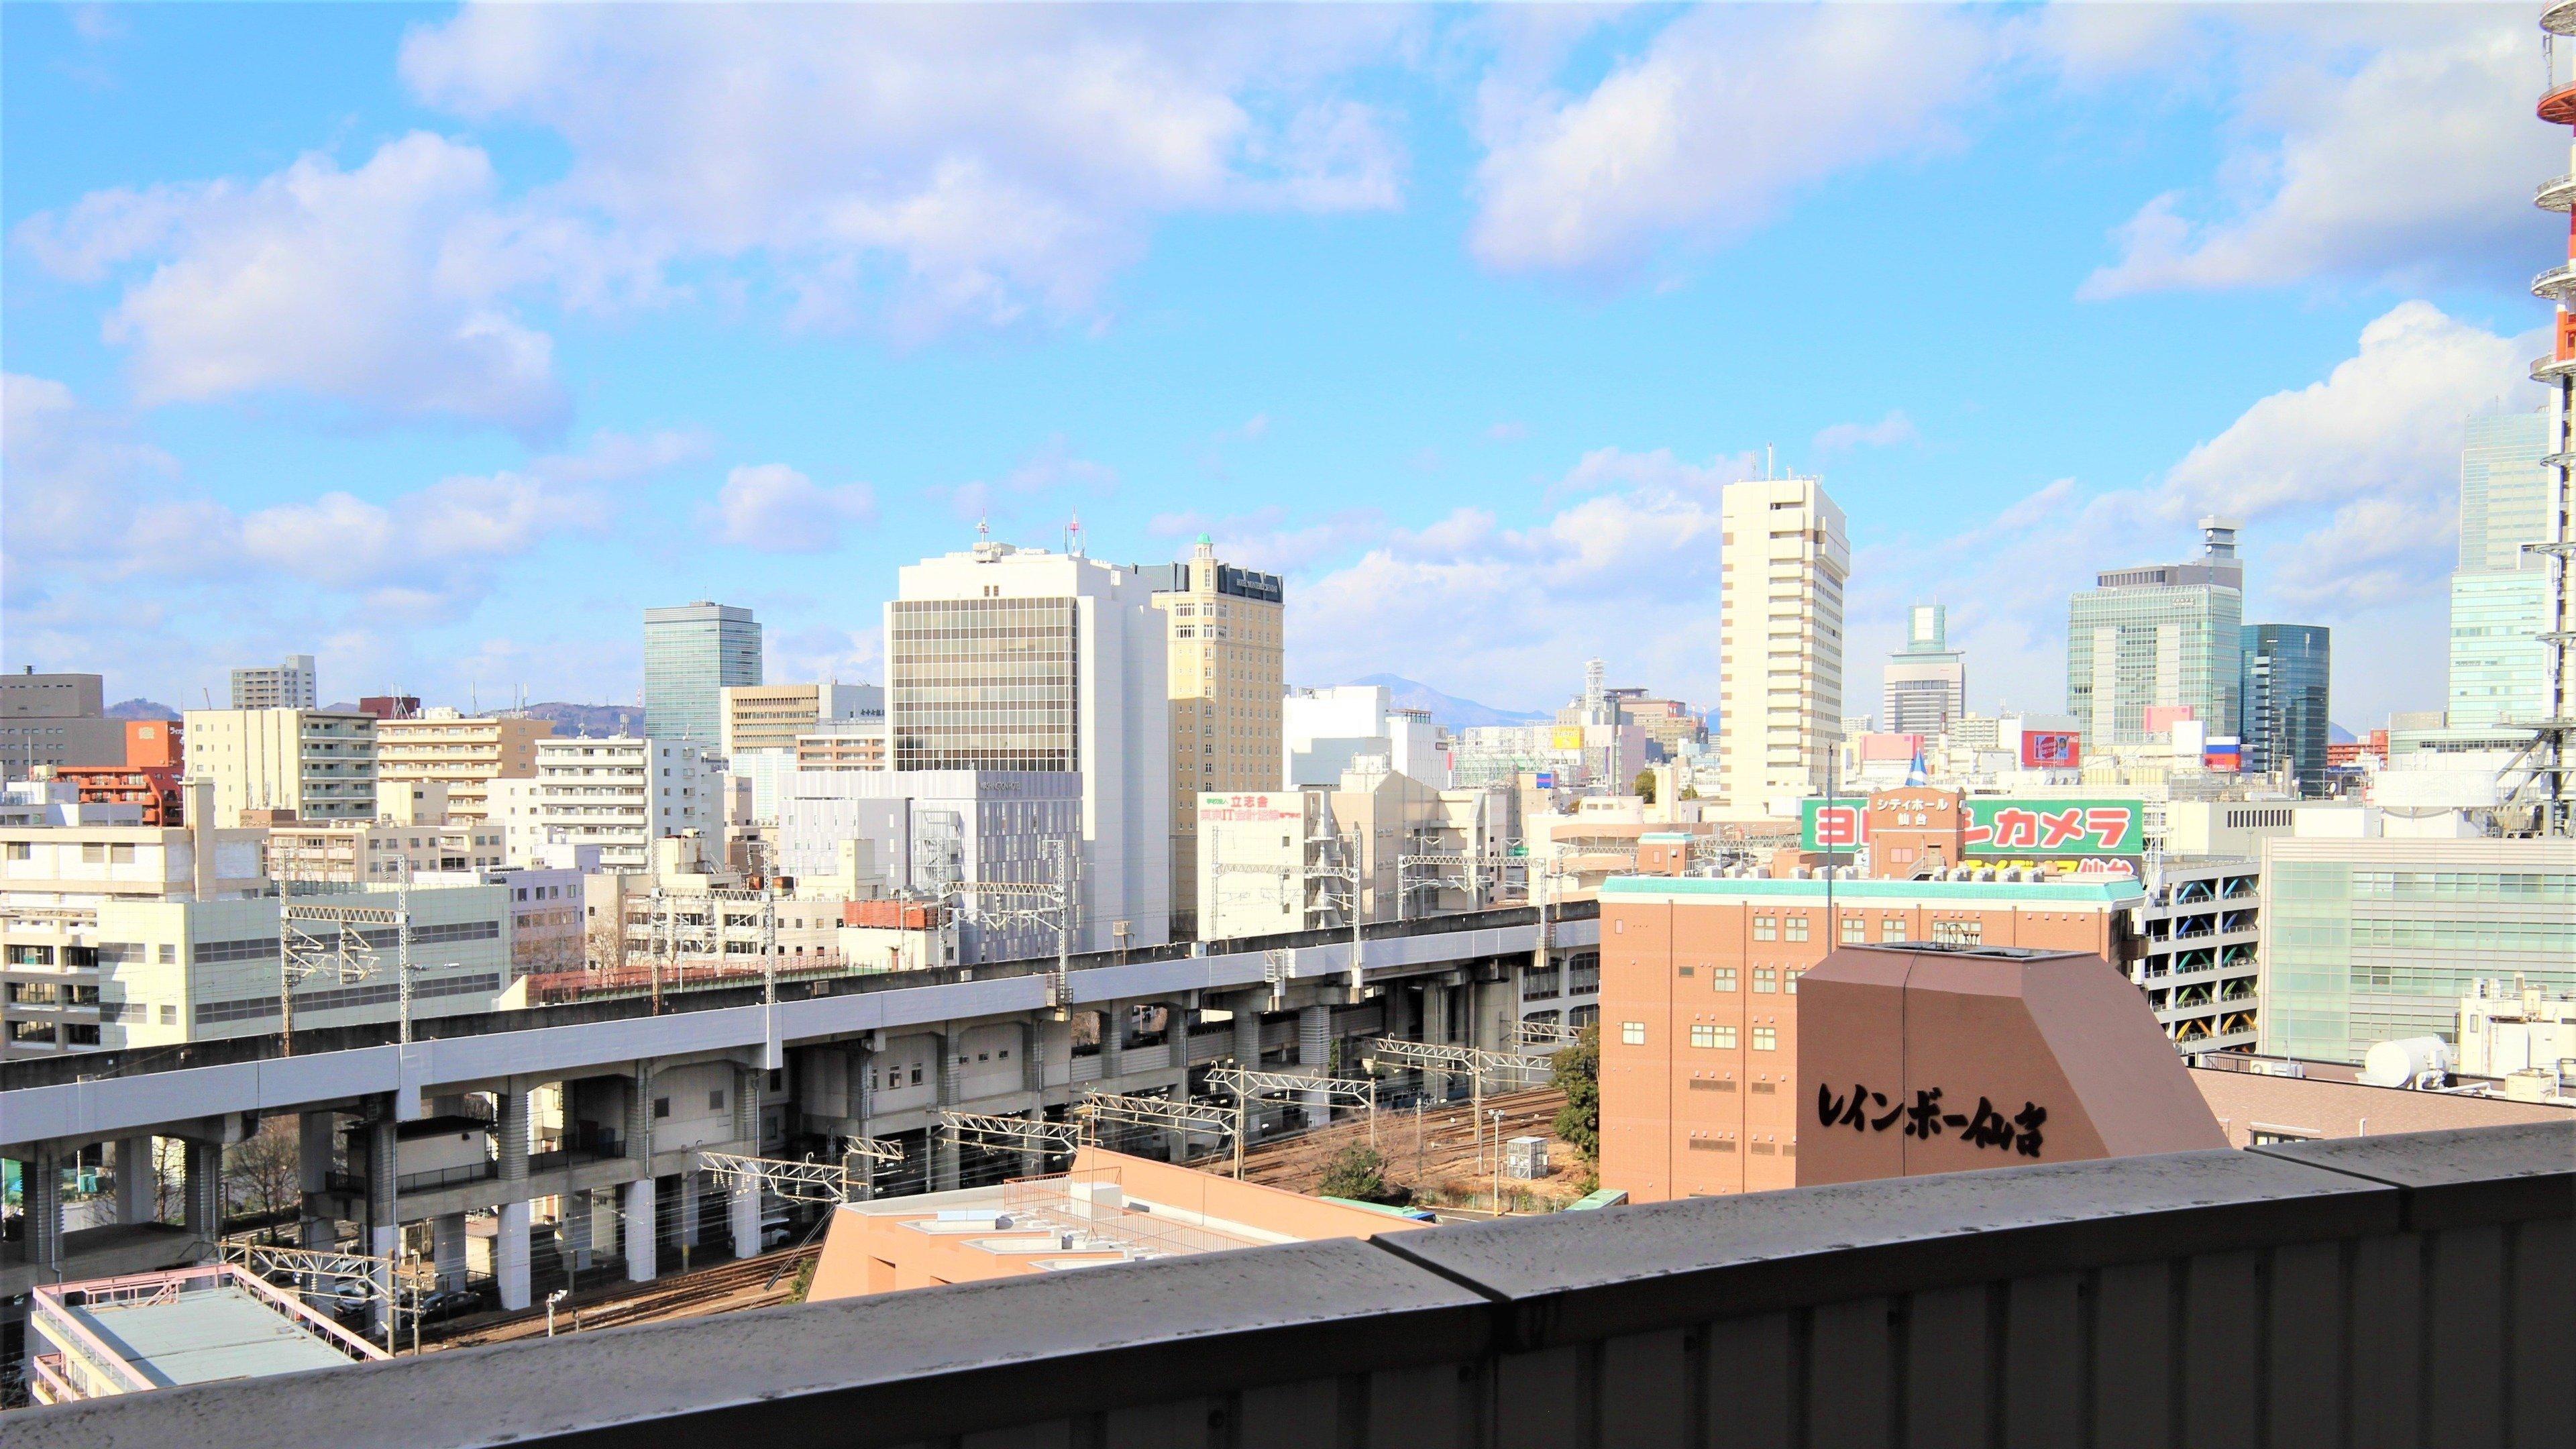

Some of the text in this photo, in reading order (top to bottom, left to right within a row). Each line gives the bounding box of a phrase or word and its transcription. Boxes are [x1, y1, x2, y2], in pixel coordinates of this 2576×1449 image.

[1877, 798, 1948, 811] シティホール
[1897, 813, 1927, 826] 仙台
[1818, 1083, 2047, 1158] レインボー仙台
